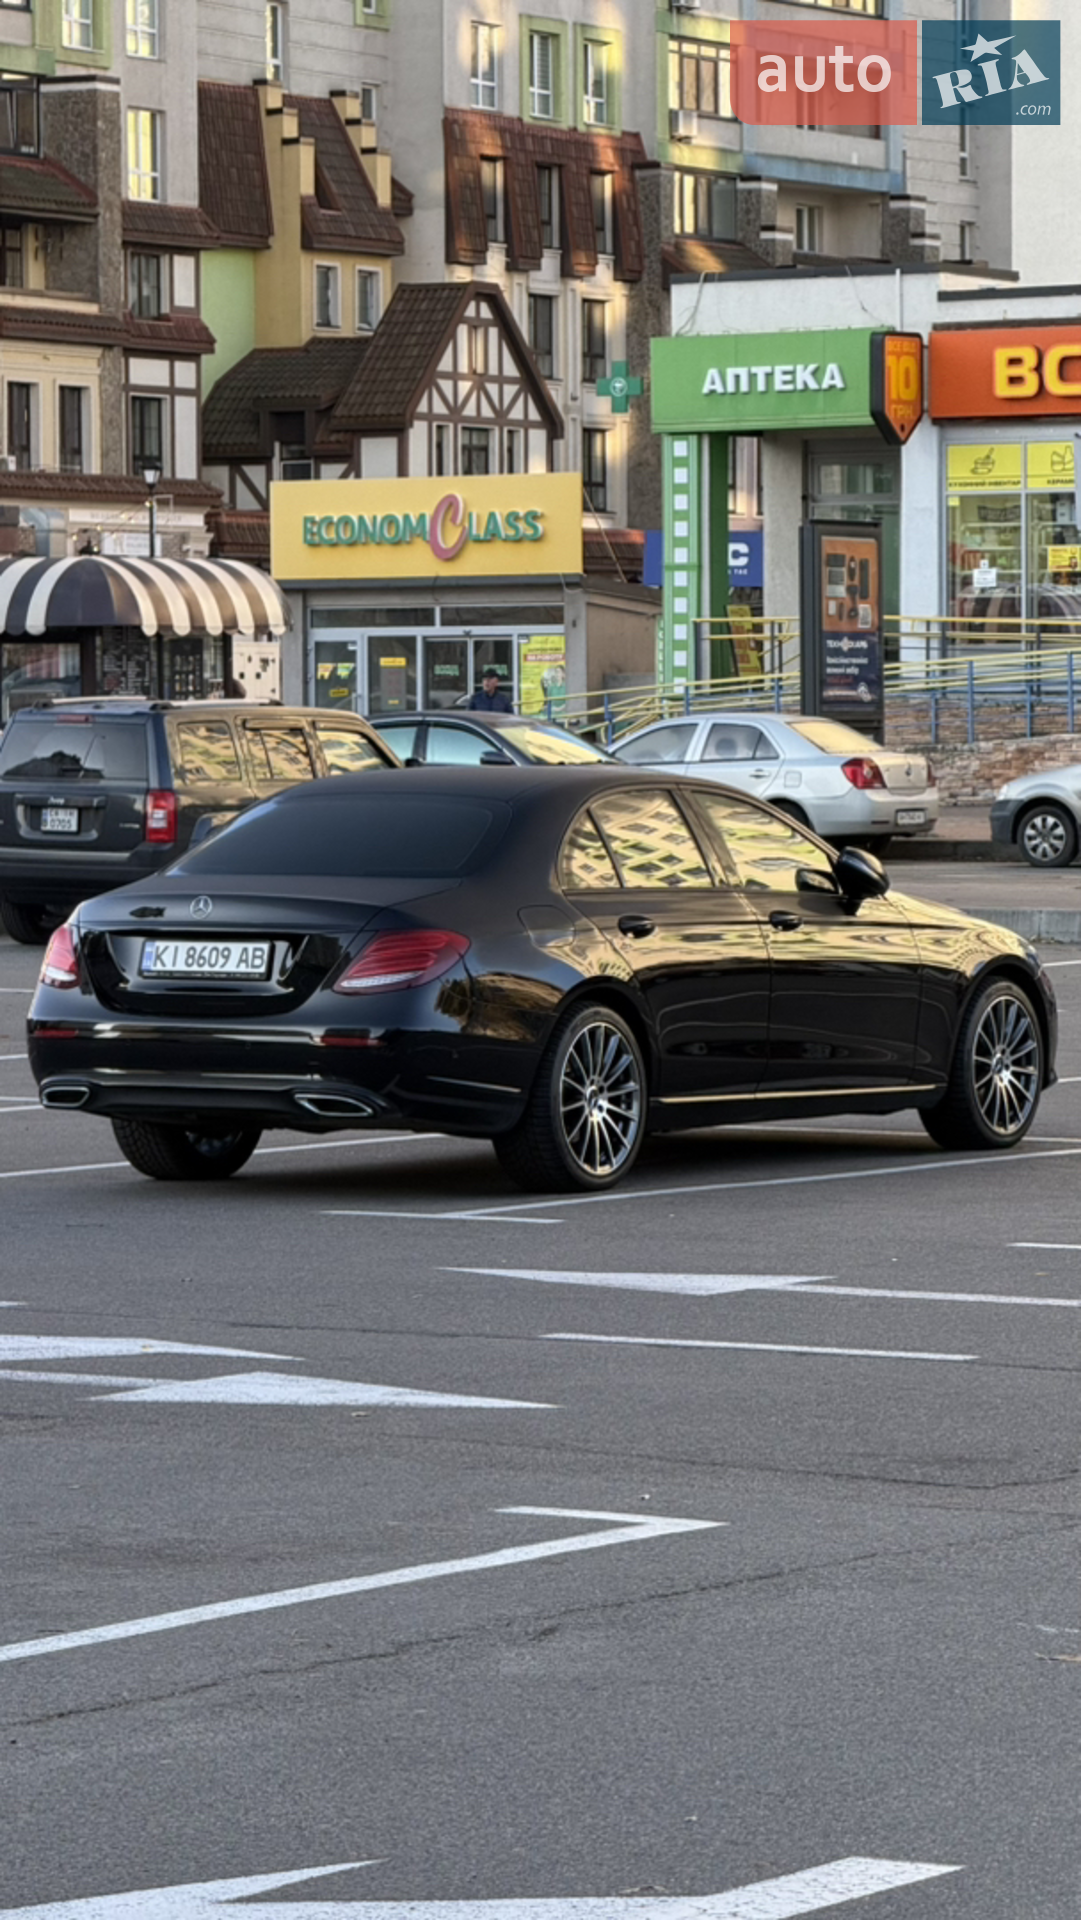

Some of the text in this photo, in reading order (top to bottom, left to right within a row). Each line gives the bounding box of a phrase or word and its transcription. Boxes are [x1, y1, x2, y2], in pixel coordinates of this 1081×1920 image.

[701, 362, 846, 395] АПТЕКА
[886, 354, 919, 402] 10
[152, 945, 266, 970] KI 8609 AB
